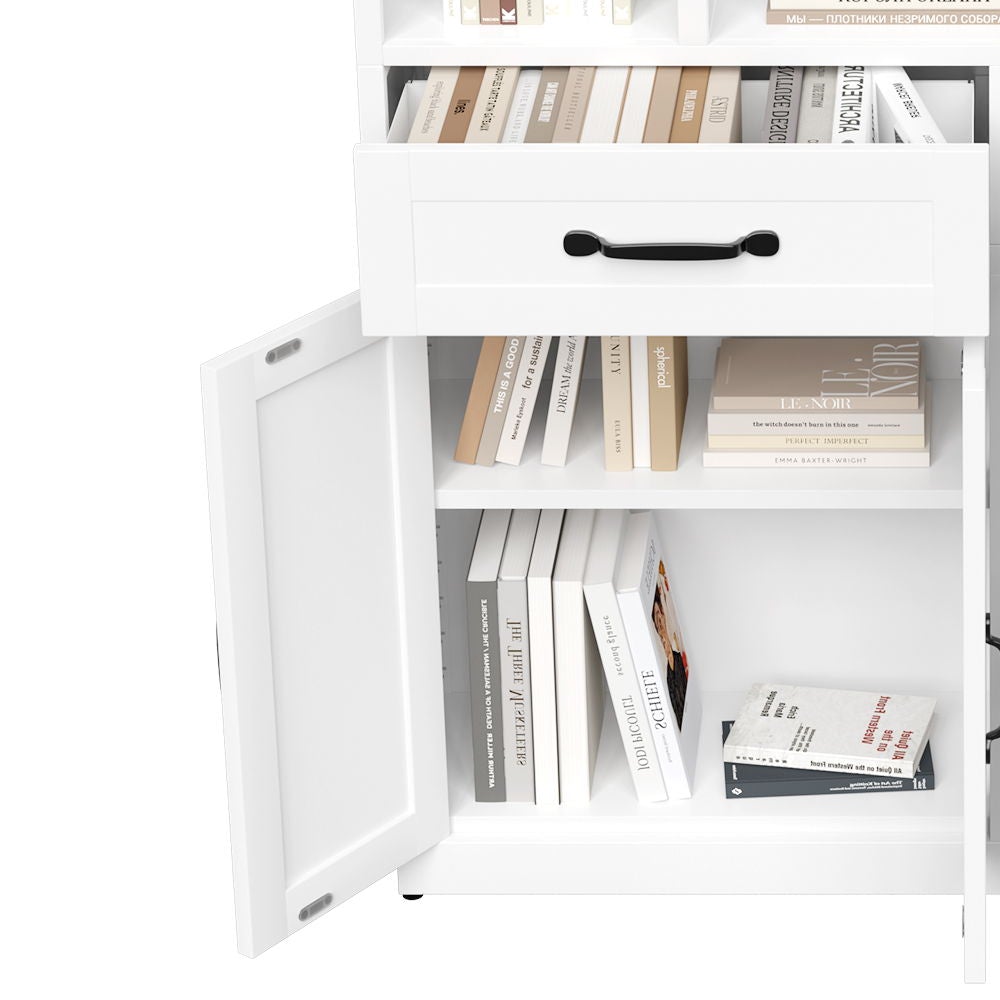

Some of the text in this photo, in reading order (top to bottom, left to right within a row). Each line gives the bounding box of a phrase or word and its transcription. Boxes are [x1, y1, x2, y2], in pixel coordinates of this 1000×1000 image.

[786, 15, 806, 24] МЫ
[826, 14, 887, 24] ПЛОТНИКИ
[890, 14, 958, 24] НЕЗРИМОГО
[494, 338, 519, 414] THIS IS A GOOD
[557, 376, 571, 414] DREAM
[564, 362, 573, 374] the
[653, 347, 671, 388] spherical
[870, 341, 919, 397] NOIR
[780, 398, 852, 409] LE NOIR
